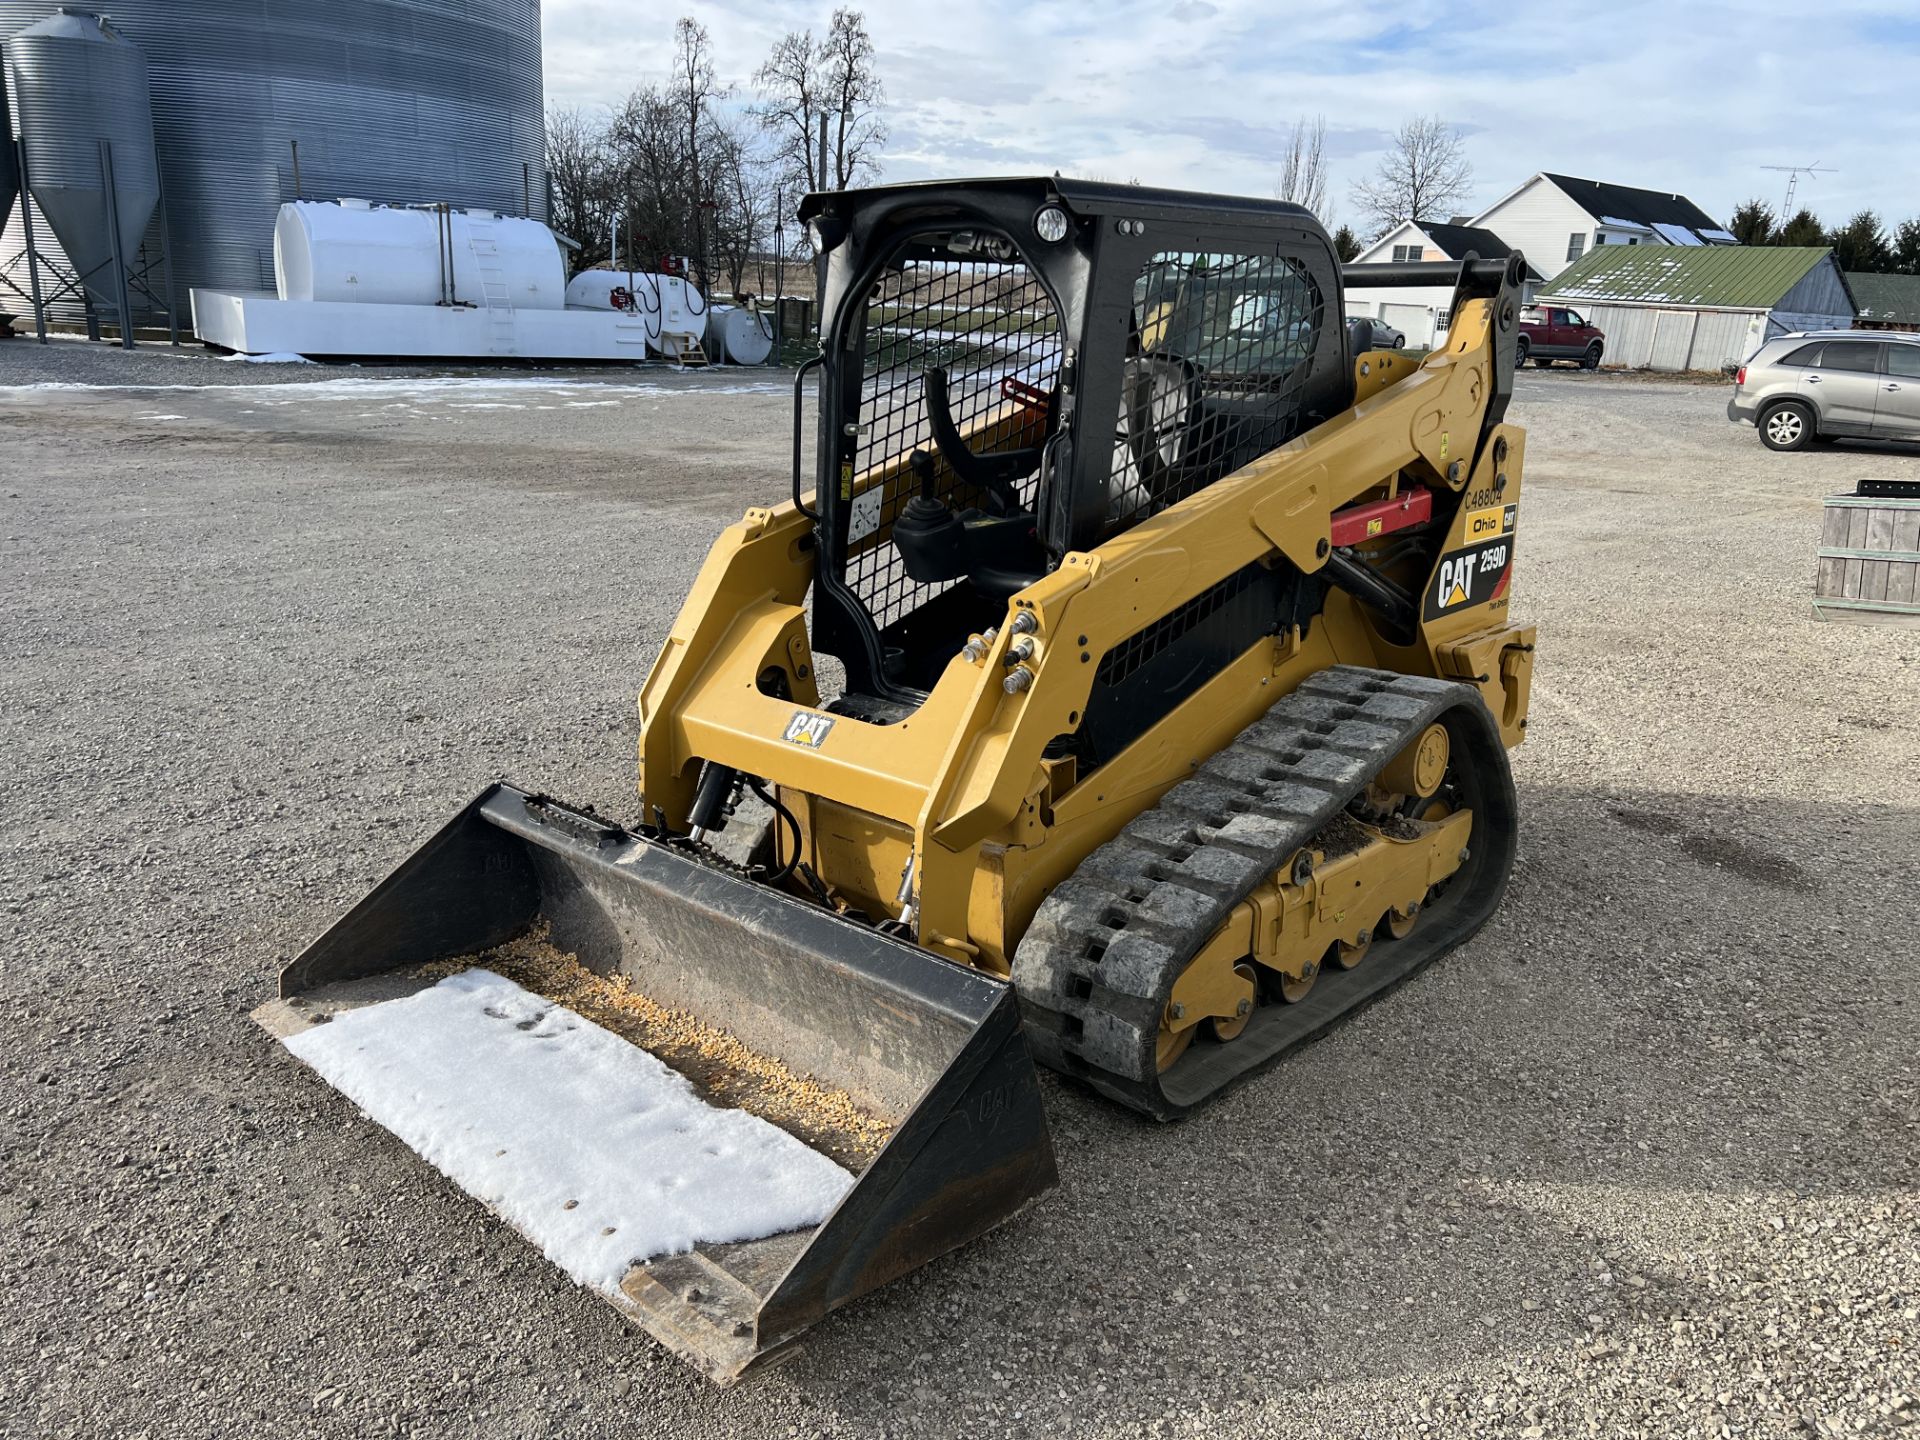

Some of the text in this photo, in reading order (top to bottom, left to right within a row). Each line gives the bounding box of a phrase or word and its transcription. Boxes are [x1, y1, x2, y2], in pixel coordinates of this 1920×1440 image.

[1465, 489, 1502, 510] C48804
[1473, 517, 1497, 533] Ohio
[1504, 511, 1515, 527] CAT
[1438, 545, 1506, 609] CAT 259D
[785, 713, 831, 746] CAT
